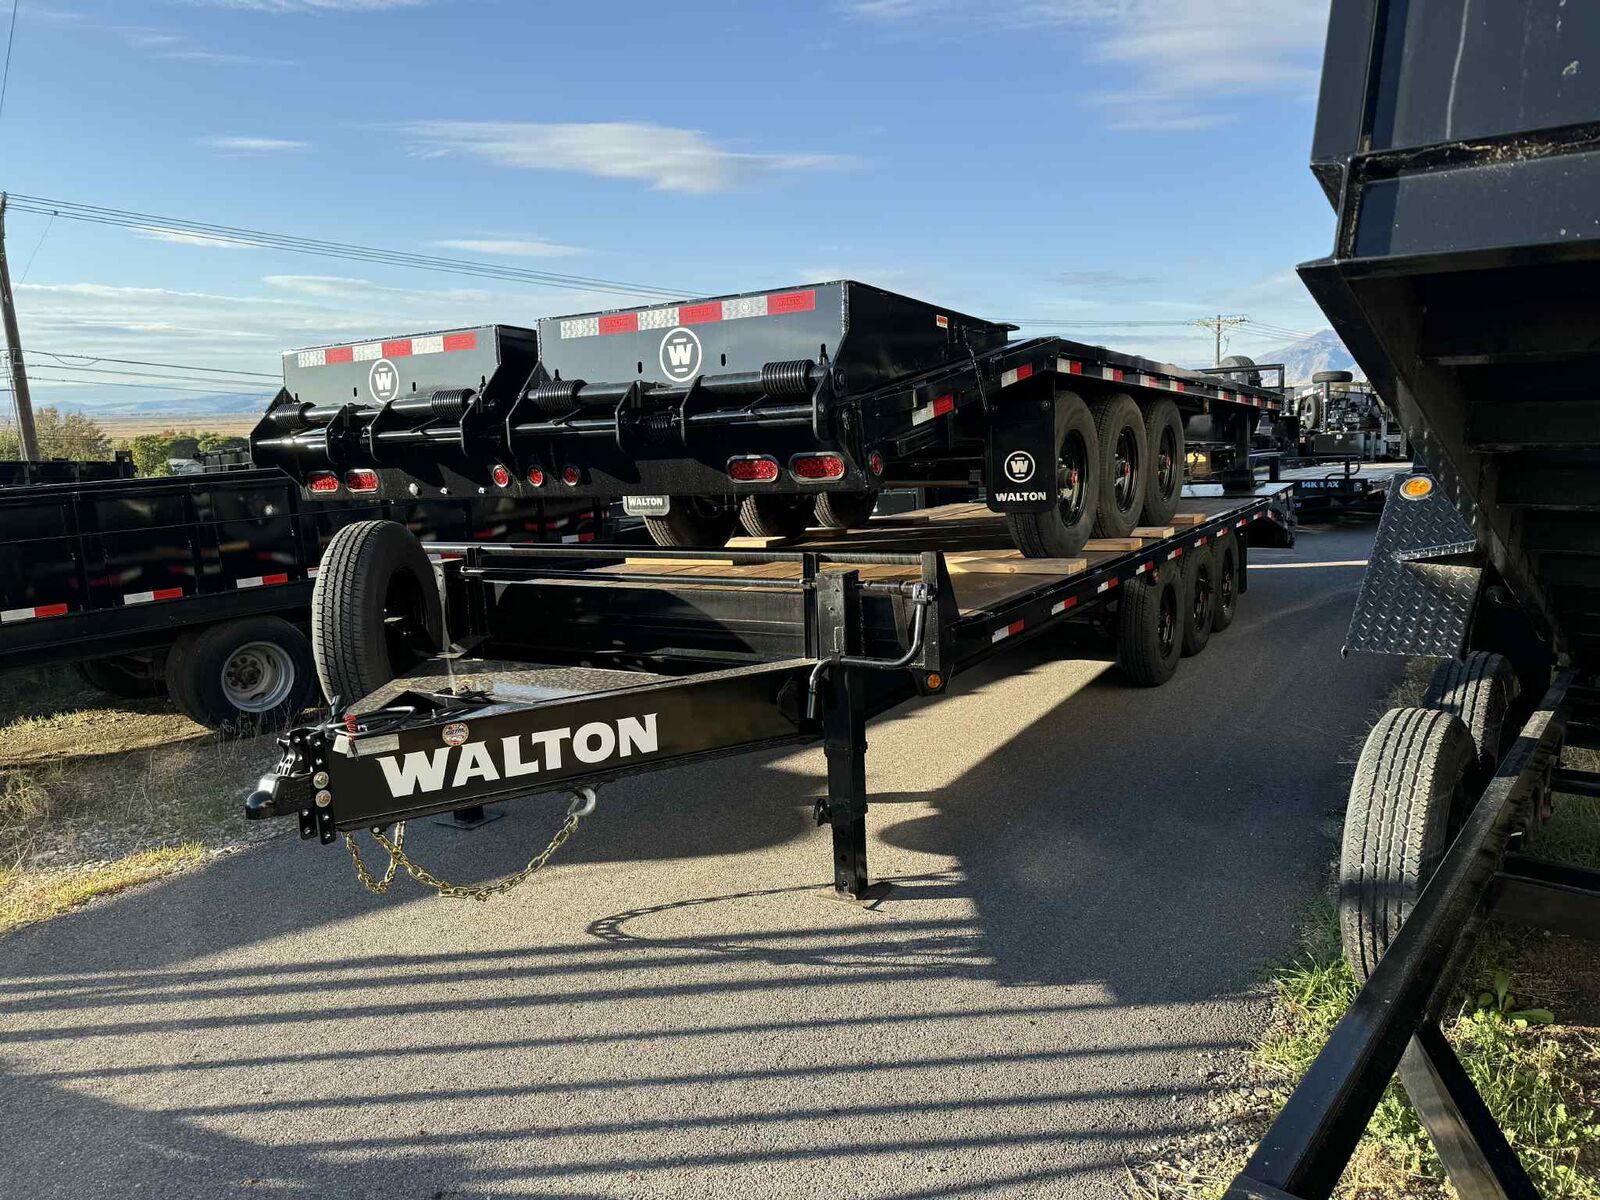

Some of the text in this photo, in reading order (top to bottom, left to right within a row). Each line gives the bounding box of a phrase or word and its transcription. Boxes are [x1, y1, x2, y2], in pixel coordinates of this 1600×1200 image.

[667, 343, 693, 366] W
[374, 372, 392, 391] W
[1010, 461, 1029, 473] W
[628, 497, 663, 506] WALTON
[995, 492, 1047, 502] WALTON
[375, 713, 658, 798] WALTON
